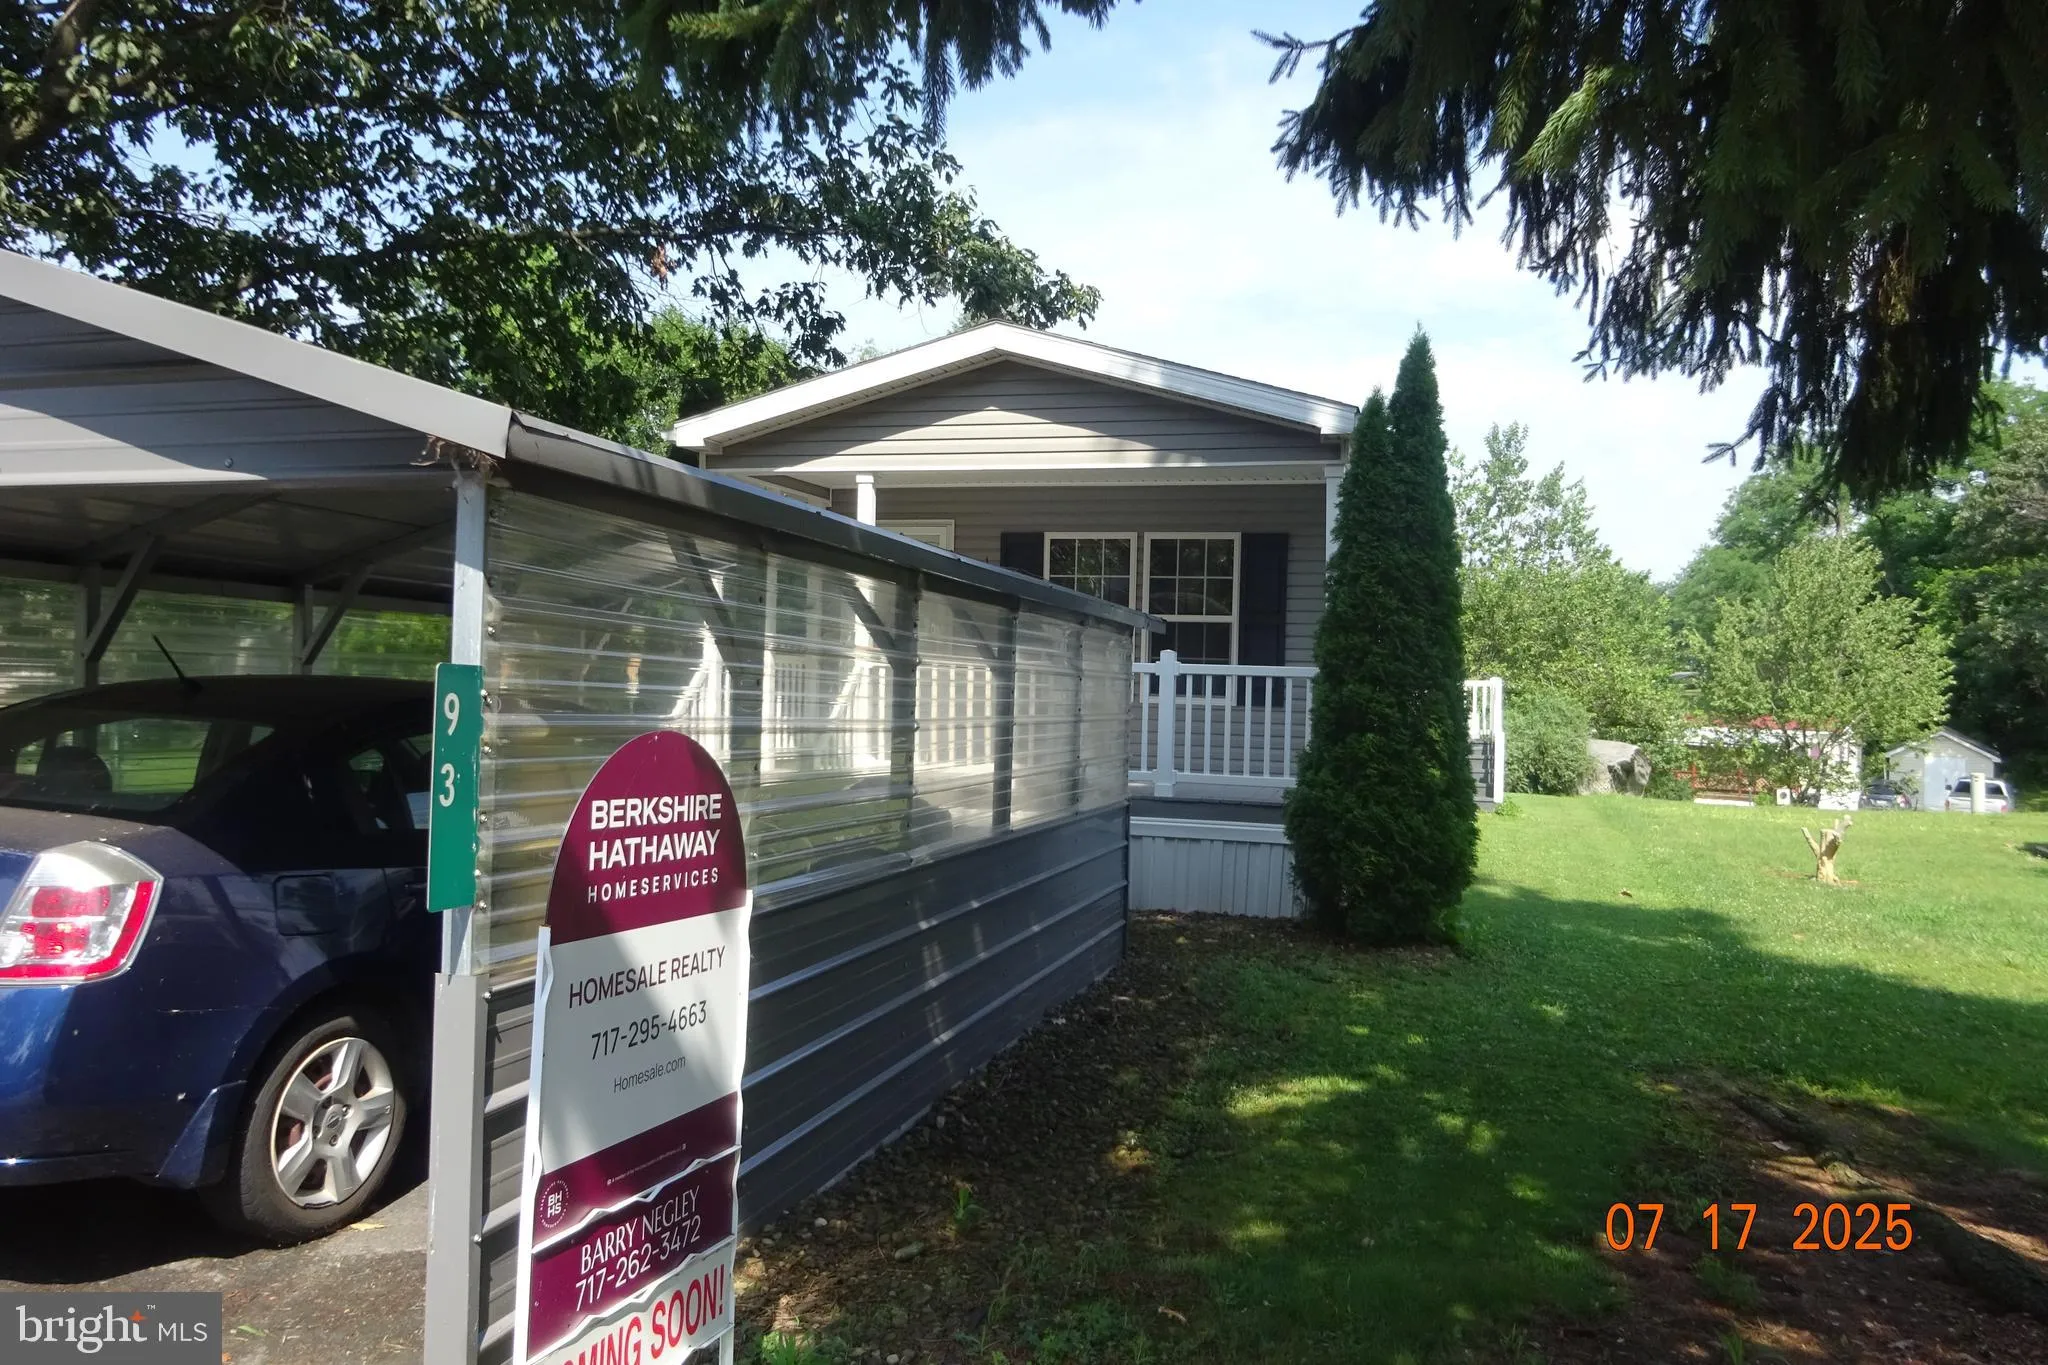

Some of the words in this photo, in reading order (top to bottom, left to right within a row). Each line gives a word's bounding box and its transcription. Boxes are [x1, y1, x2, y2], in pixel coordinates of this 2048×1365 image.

[590, 793, 723, 830] BERKSHIRE
[588, 829, 721, 872] HATHAWAY
[587, 867, 719, 904] HOMESERVICES
[568, 960, 667, 1009] HOMESALE
[671, 945, 726, 980] REALTY
[591, 1000, 707, 1060] 717-295-4663
[613, 1055, 686, 1093] Homesale.com
[547, 1190, 563, 1207] BH
[547, 1202, 562, 1218] HS
[580, 1218, 638, 1276] BARRY
[641, 1186, 700, 1240] NEGLEY
[575, 1215, 701, 1312] 717-262-3472
[563, 1316, 642, 1365] ING
[651, 1263, 725, 1359] SOON!
